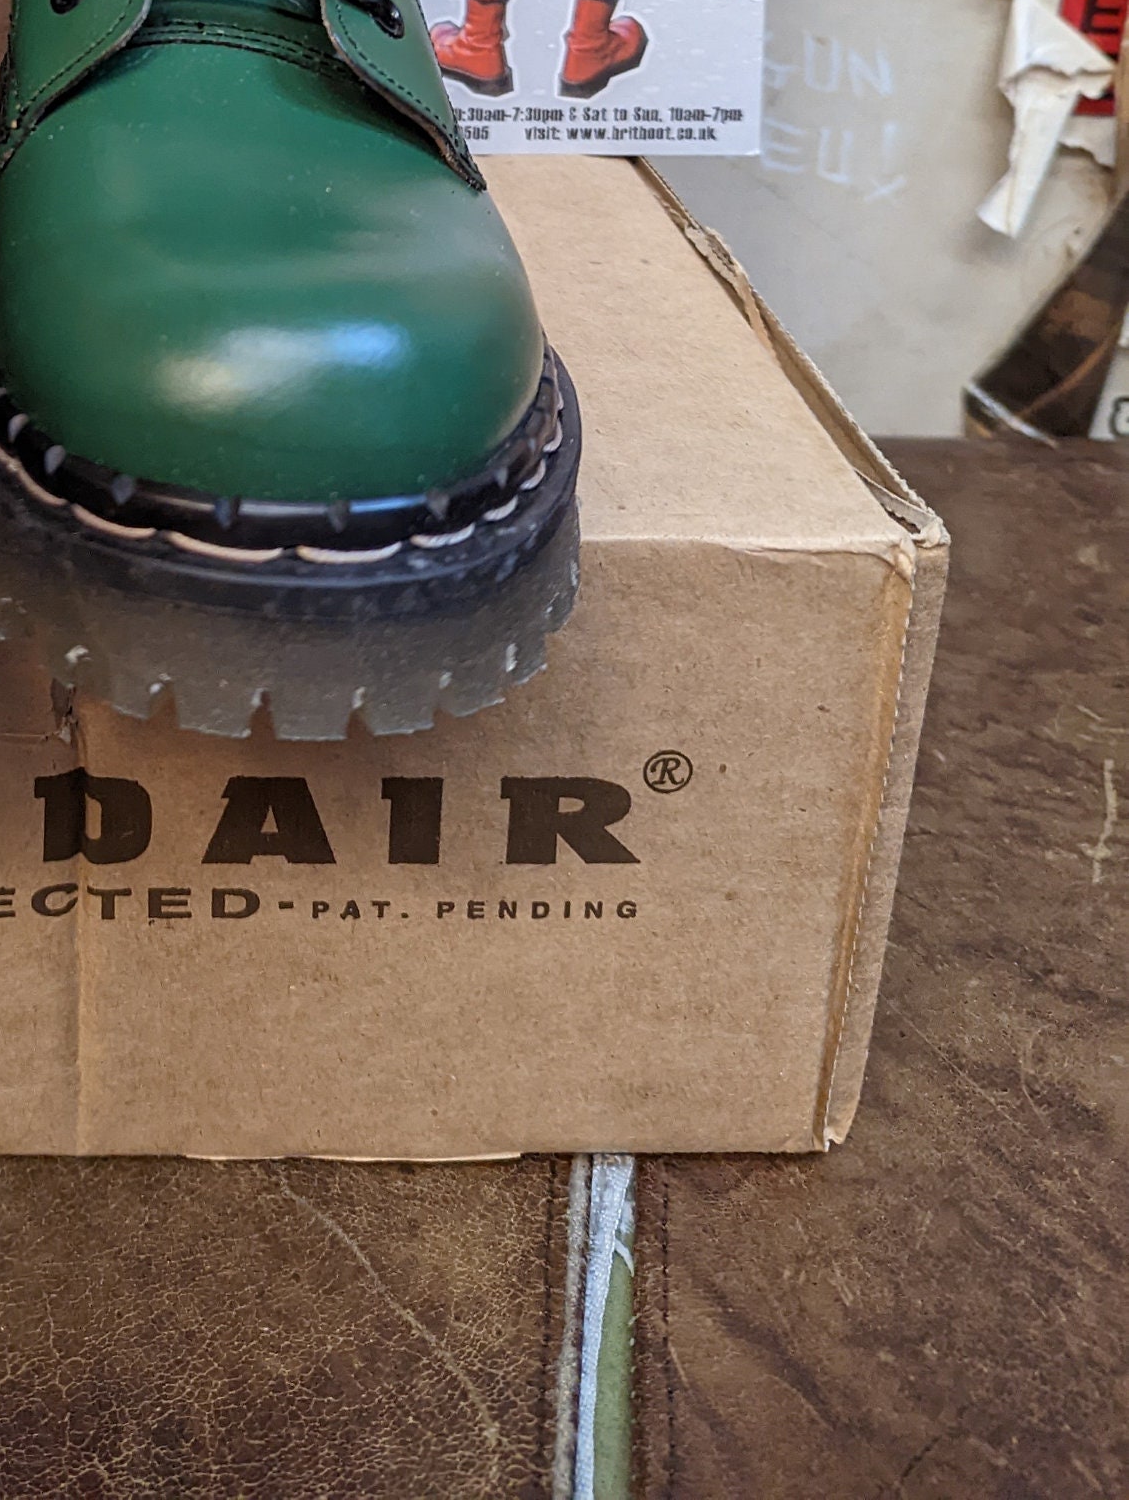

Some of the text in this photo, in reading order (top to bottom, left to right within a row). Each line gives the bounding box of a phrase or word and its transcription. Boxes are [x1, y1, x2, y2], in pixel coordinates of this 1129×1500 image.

[454, 107, 564, 123] 0:30am-7:30pm
[583, 106, 607, 122] Sat
[613, 107, 627, 122] to
[437, 900, 639, 921] PENDING
